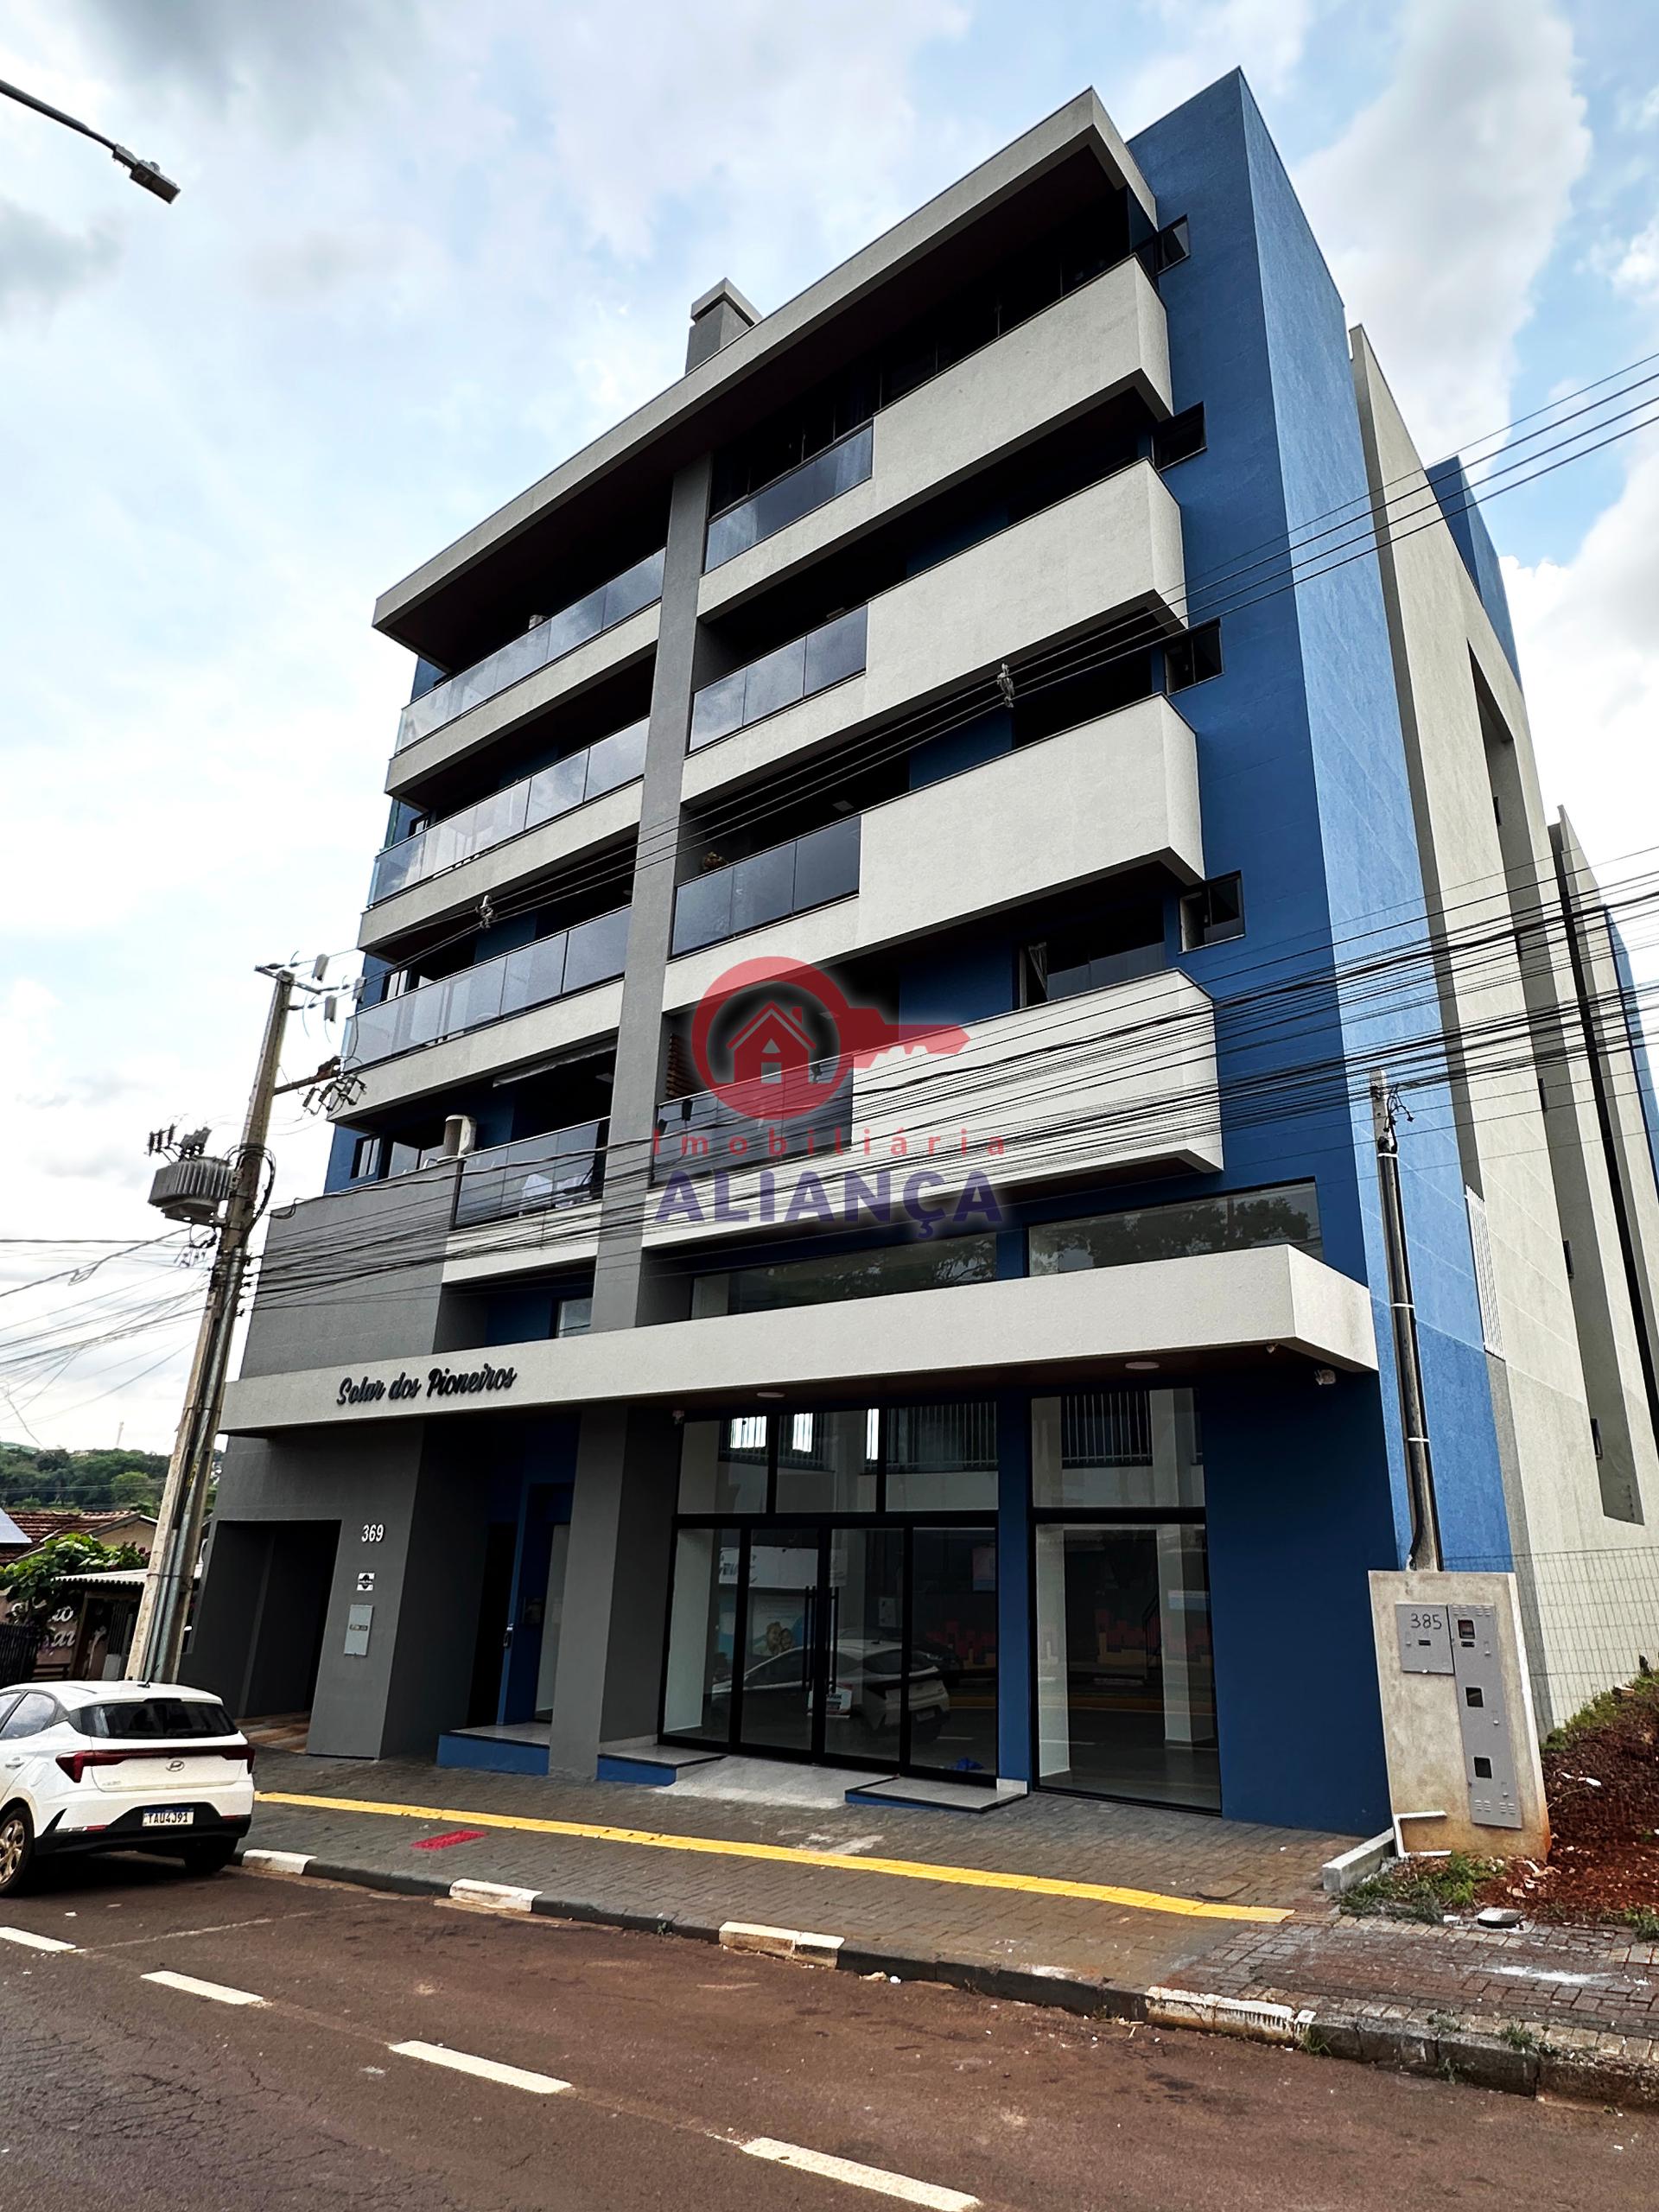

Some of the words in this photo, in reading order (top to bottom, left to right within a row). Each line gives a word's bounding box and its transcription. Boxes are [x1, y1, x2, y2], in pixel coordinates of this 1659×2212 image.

[336, 1376, 386, 1405] Solar
[388, 1371, 422, 1400] dos
[426, 1363, 518, 1398] Pioneiros
[361, 1523, 385, 1542] 369
[1411, 1613, 1442, 1630] 385
